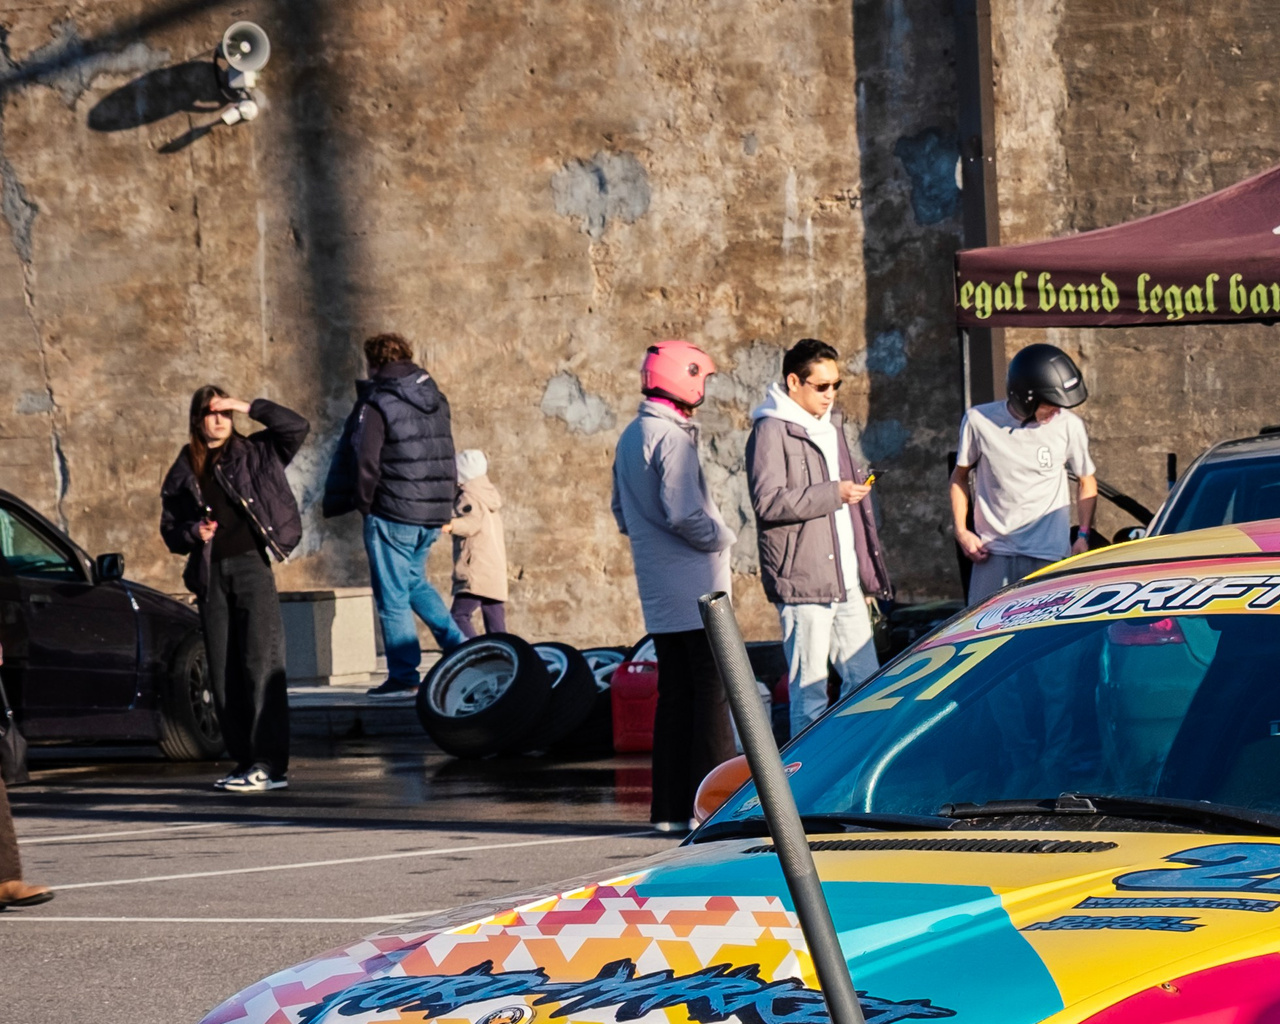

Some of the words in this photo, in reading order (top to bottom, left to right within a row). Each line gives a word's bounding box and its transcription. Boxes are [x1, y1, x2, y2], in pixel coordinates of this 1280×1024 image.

[958, 271, 1028, 319] egal
[1037, 272, 1120, 312] band
[1137, 273, 1219, 320] legal
[834, 634, 1015, 718] 21
